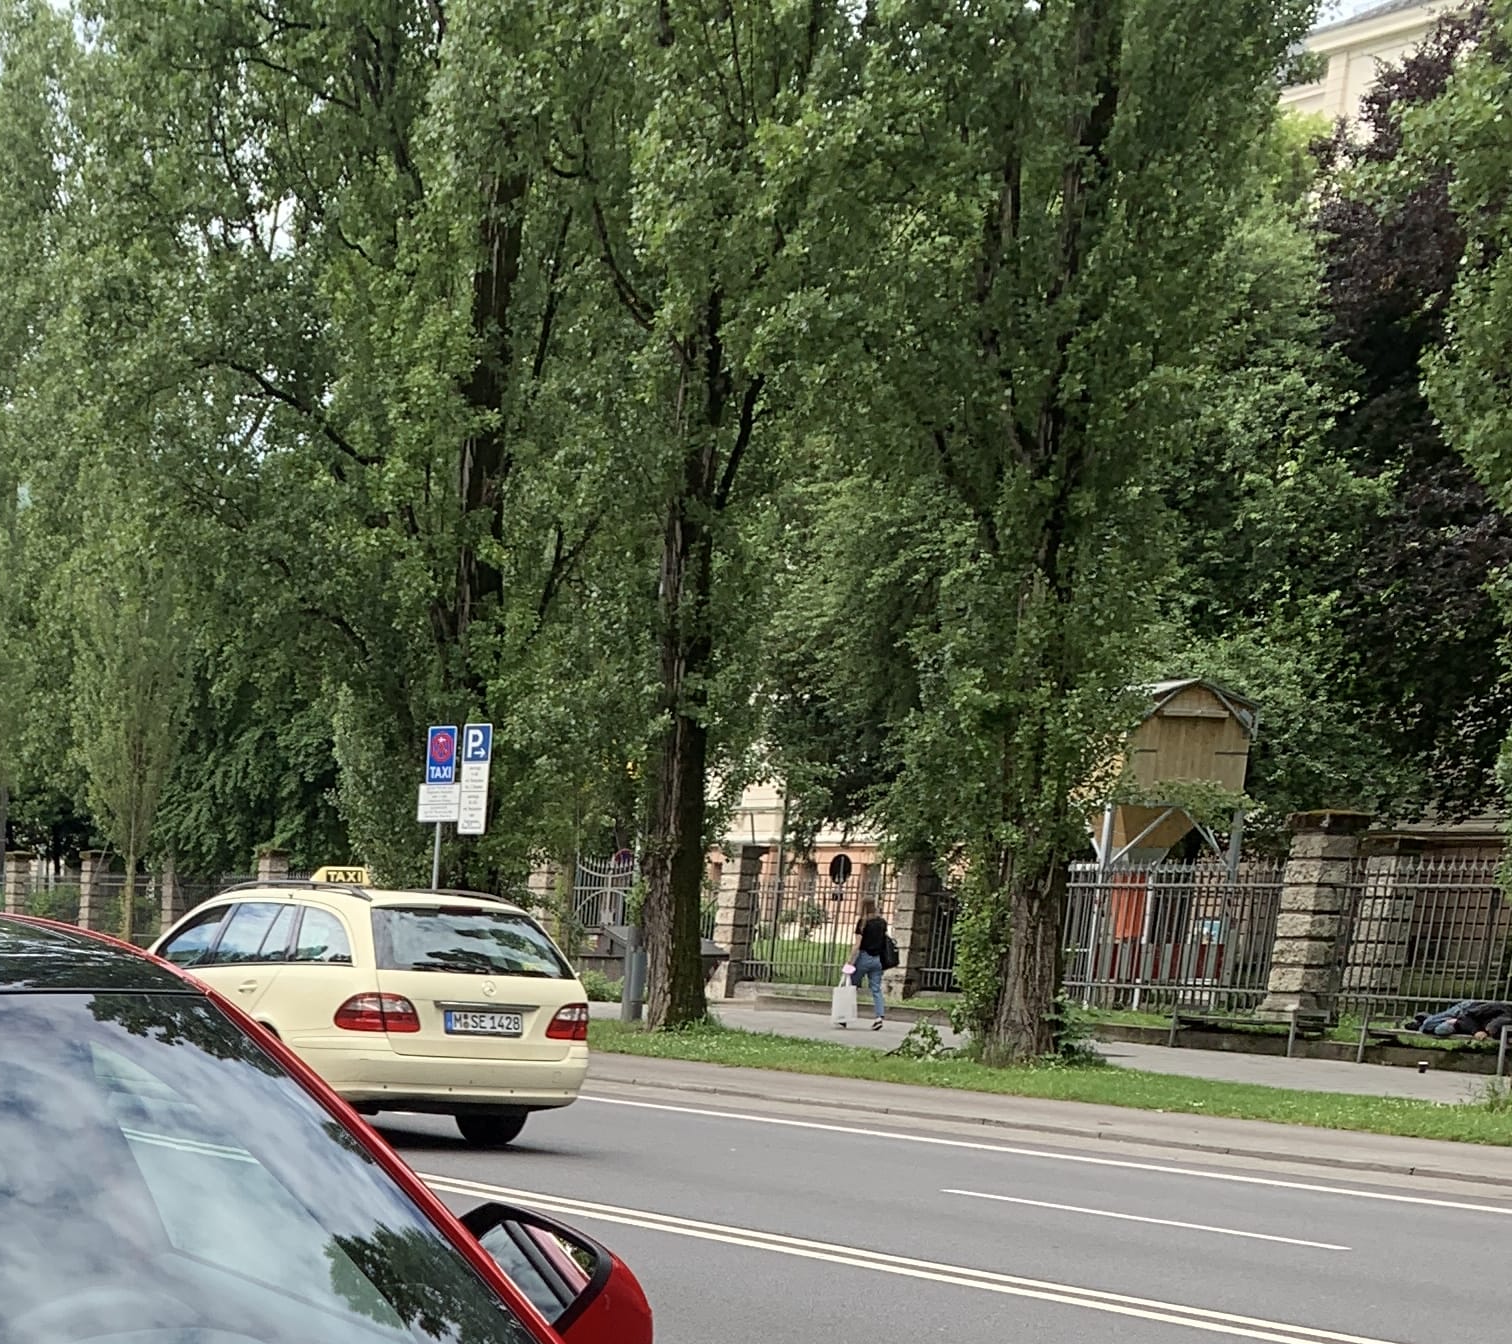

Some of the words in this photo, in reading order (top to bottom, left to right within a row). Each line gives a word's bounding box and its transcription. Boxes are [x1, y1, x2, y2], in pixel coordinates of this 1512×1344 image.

[467, 729, 484, 758] P
[429, 766, 452, 779] TAXI
[328, 870, 362, 882] TAXI
[454, 1013, 462, 1028] M
[471, 1014, 487, 1029] SE
[489, 1015, 520, 1031] 1428
